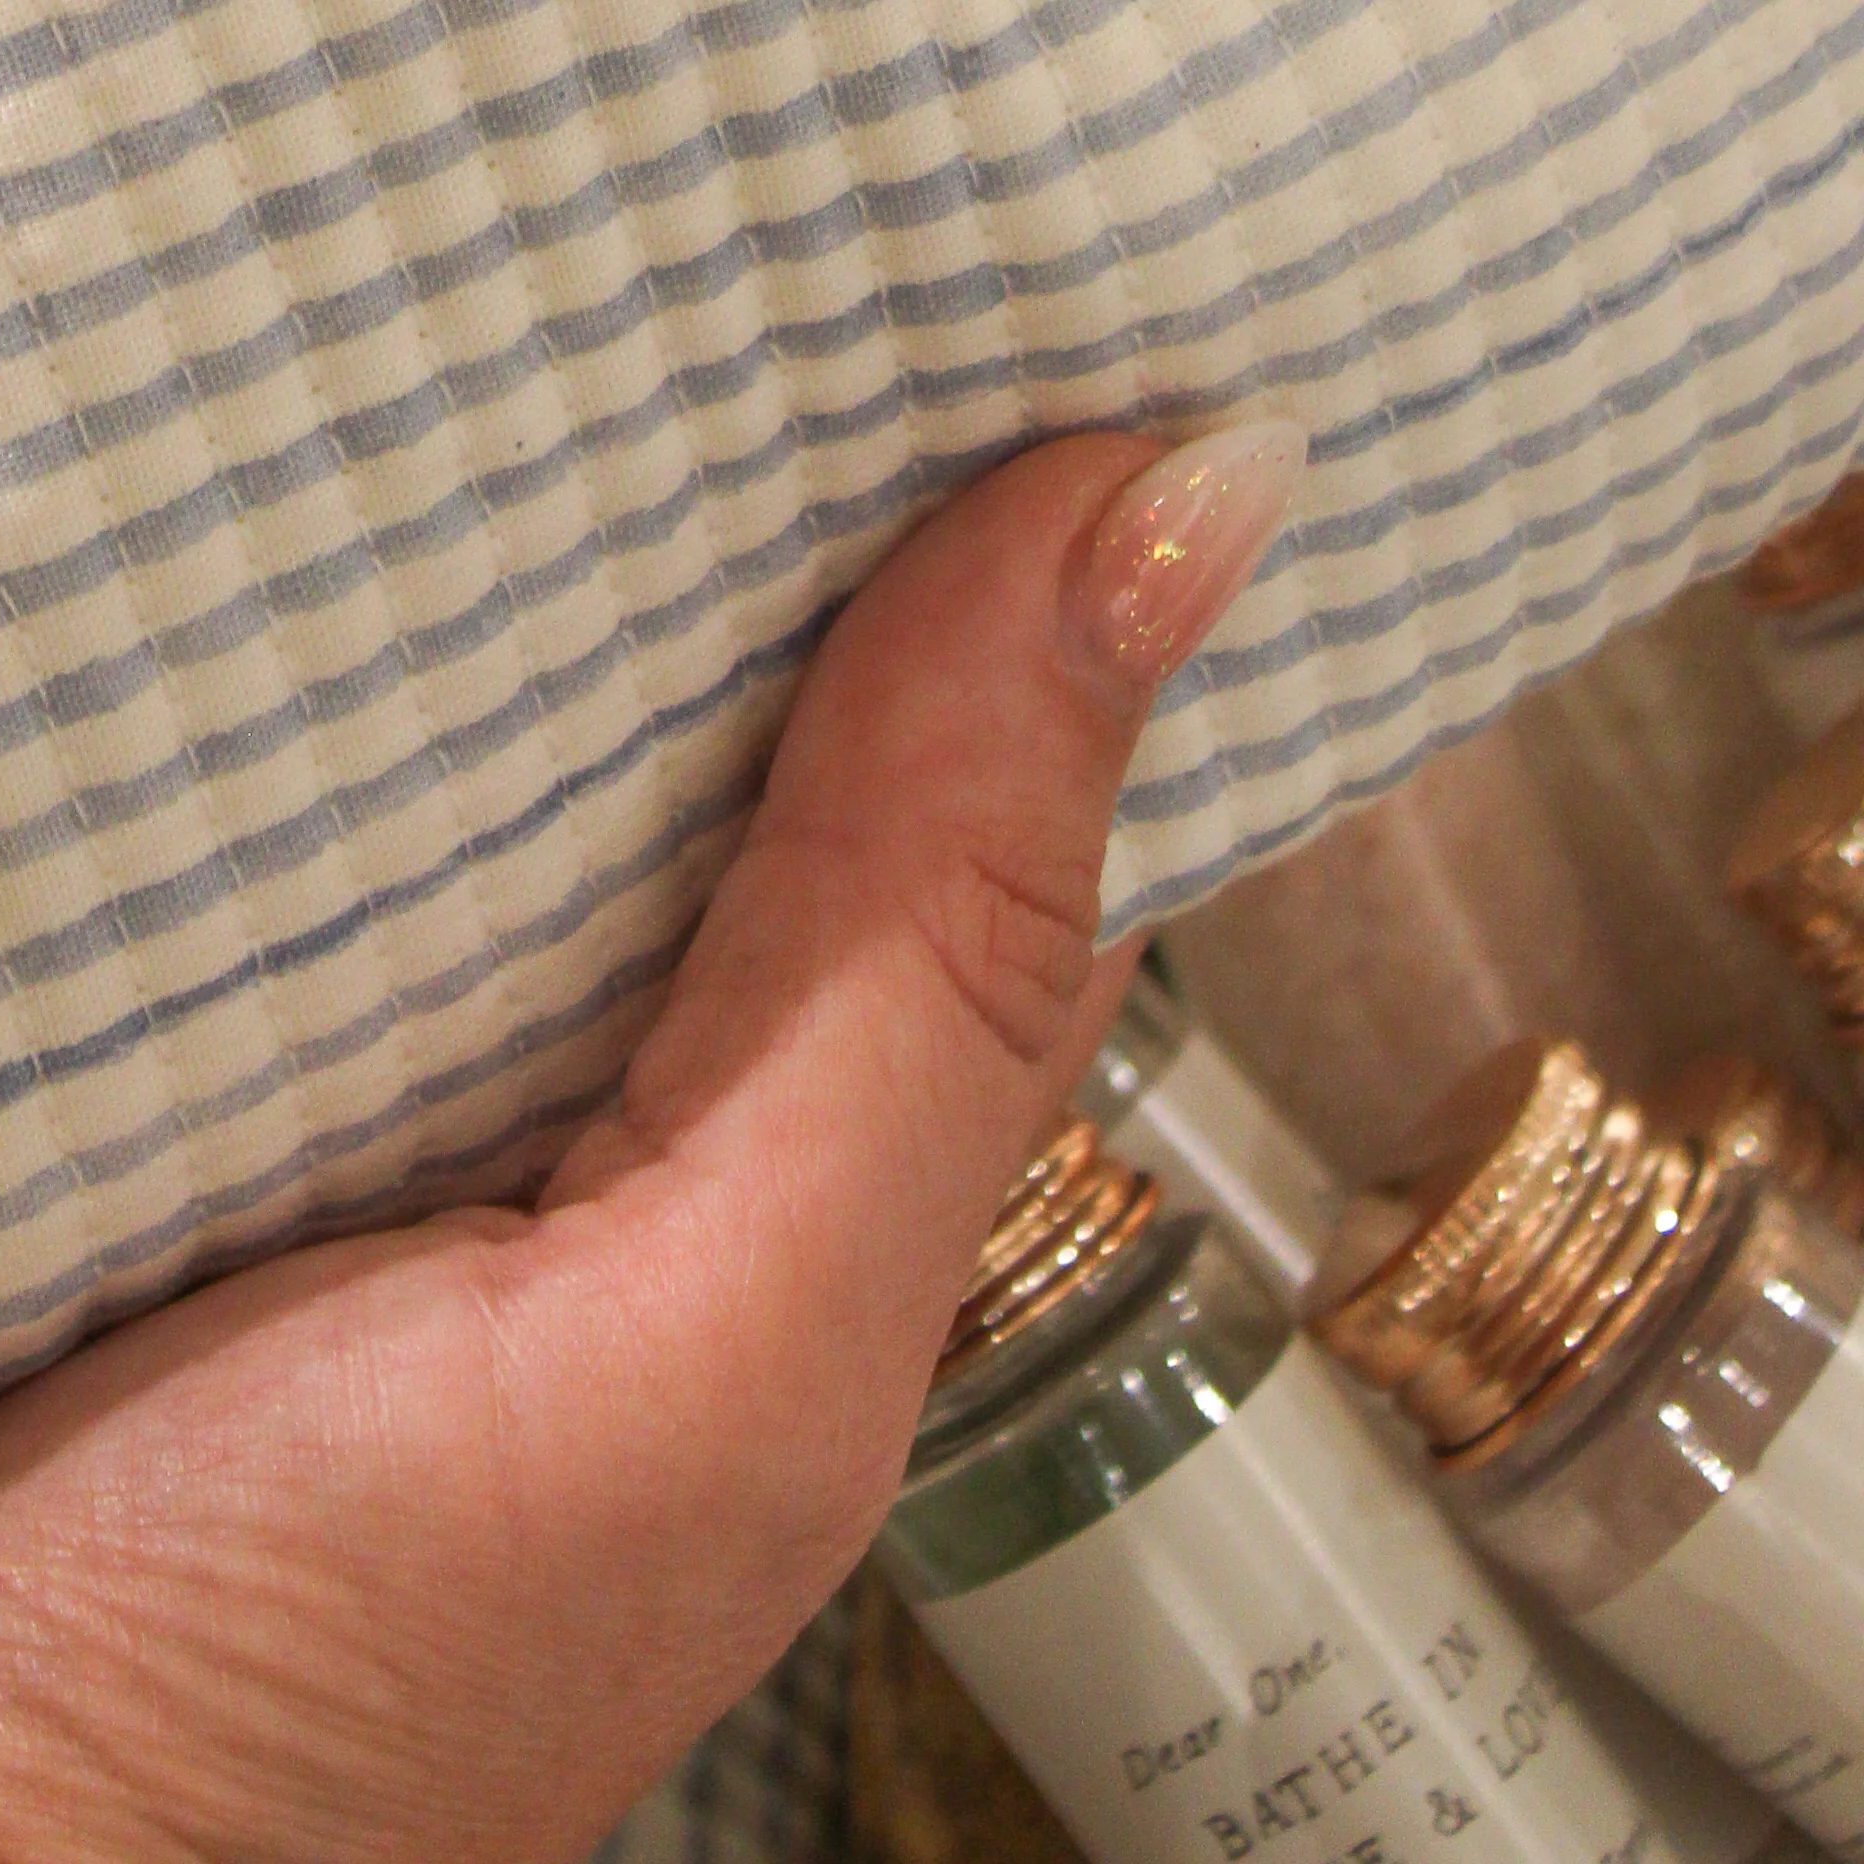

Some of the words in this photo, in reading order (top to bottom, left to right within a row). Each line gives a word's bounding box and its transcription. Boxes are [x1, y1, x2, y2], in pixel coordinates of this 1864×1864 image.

[1121, 1715, 1223, 1792] Dear
[1201, 1697, 1416, 1863] BATHE
[1422, 1620, 1482, 1704] IN
[1424, 1785, 1480, 1838] &
